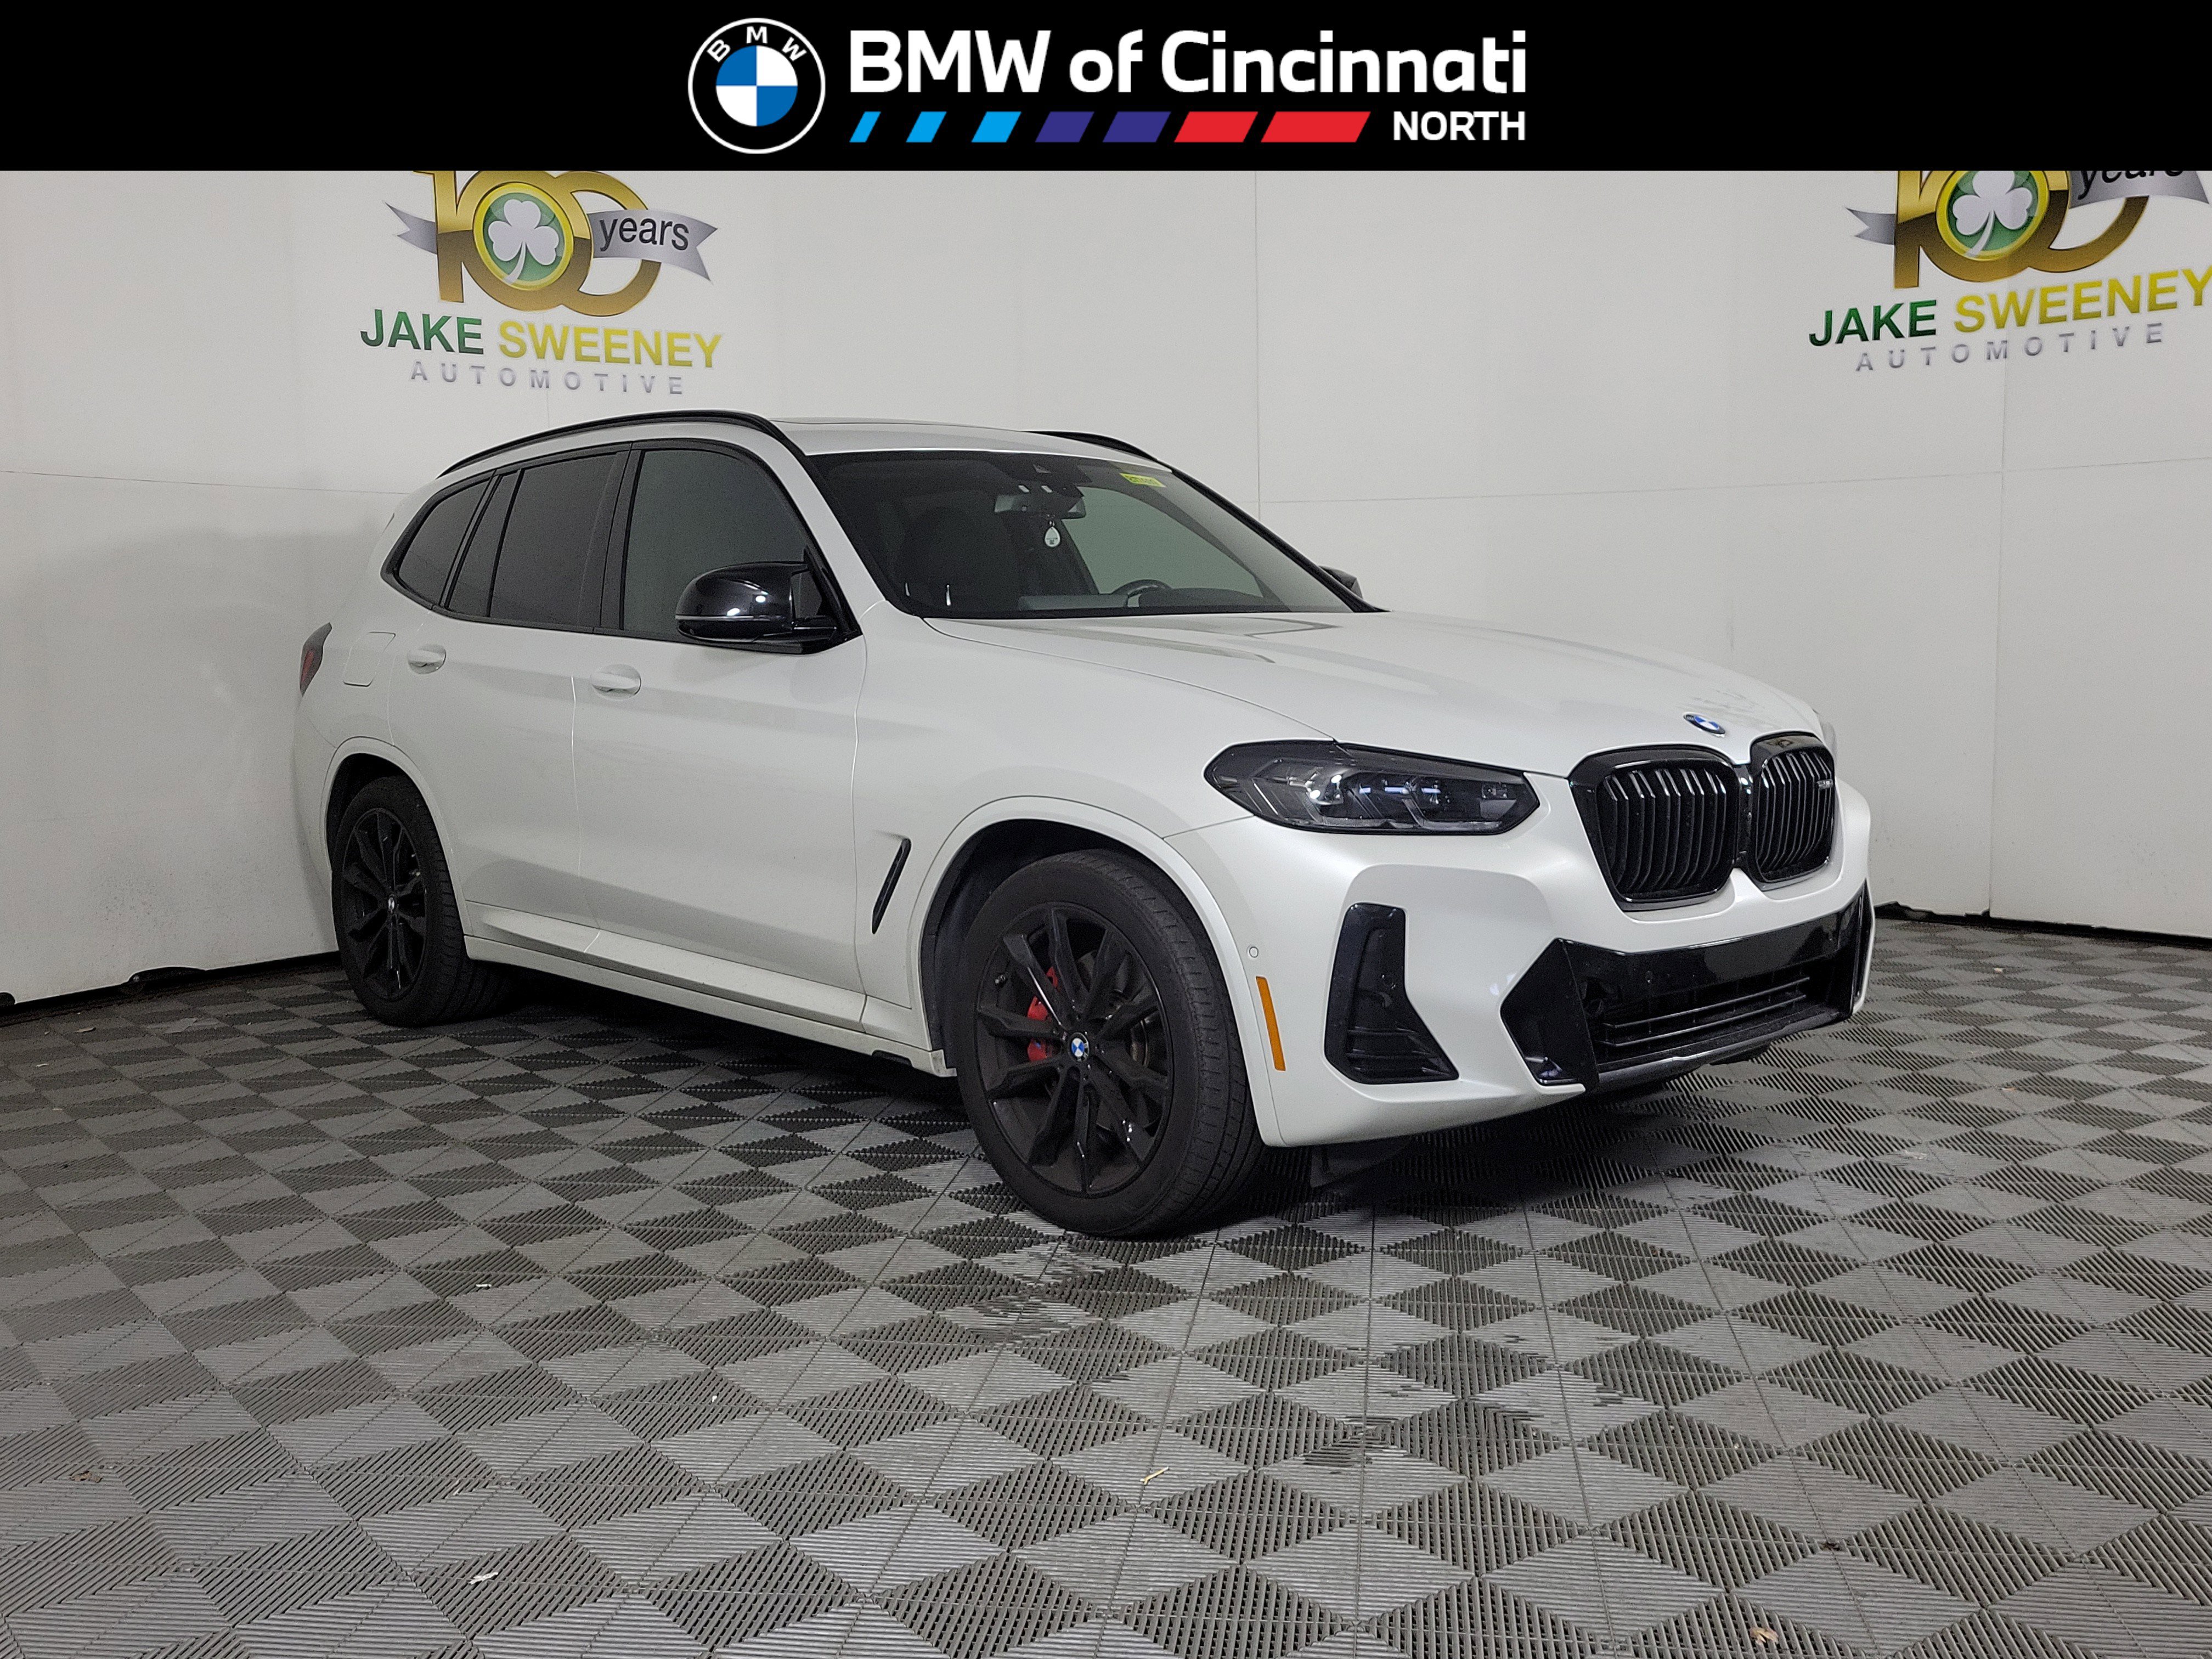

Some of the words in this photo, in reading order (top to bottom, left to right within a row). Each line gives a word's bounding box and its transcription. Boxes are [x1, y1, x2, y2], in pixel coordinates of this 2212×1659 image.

[599, 217, 690, 252] years
[1809, 300, 1937, 347] JAKE
[1953, 265, 2212, 333] SWEENEY
[360, 308, 484, 355] JAKE
[498, 320, 722, 368] SWEENEY
[1855, 322, 2163, 372] AUTOMOTIVE
[410, 360, 684, 395] AUTOMOTIVE
